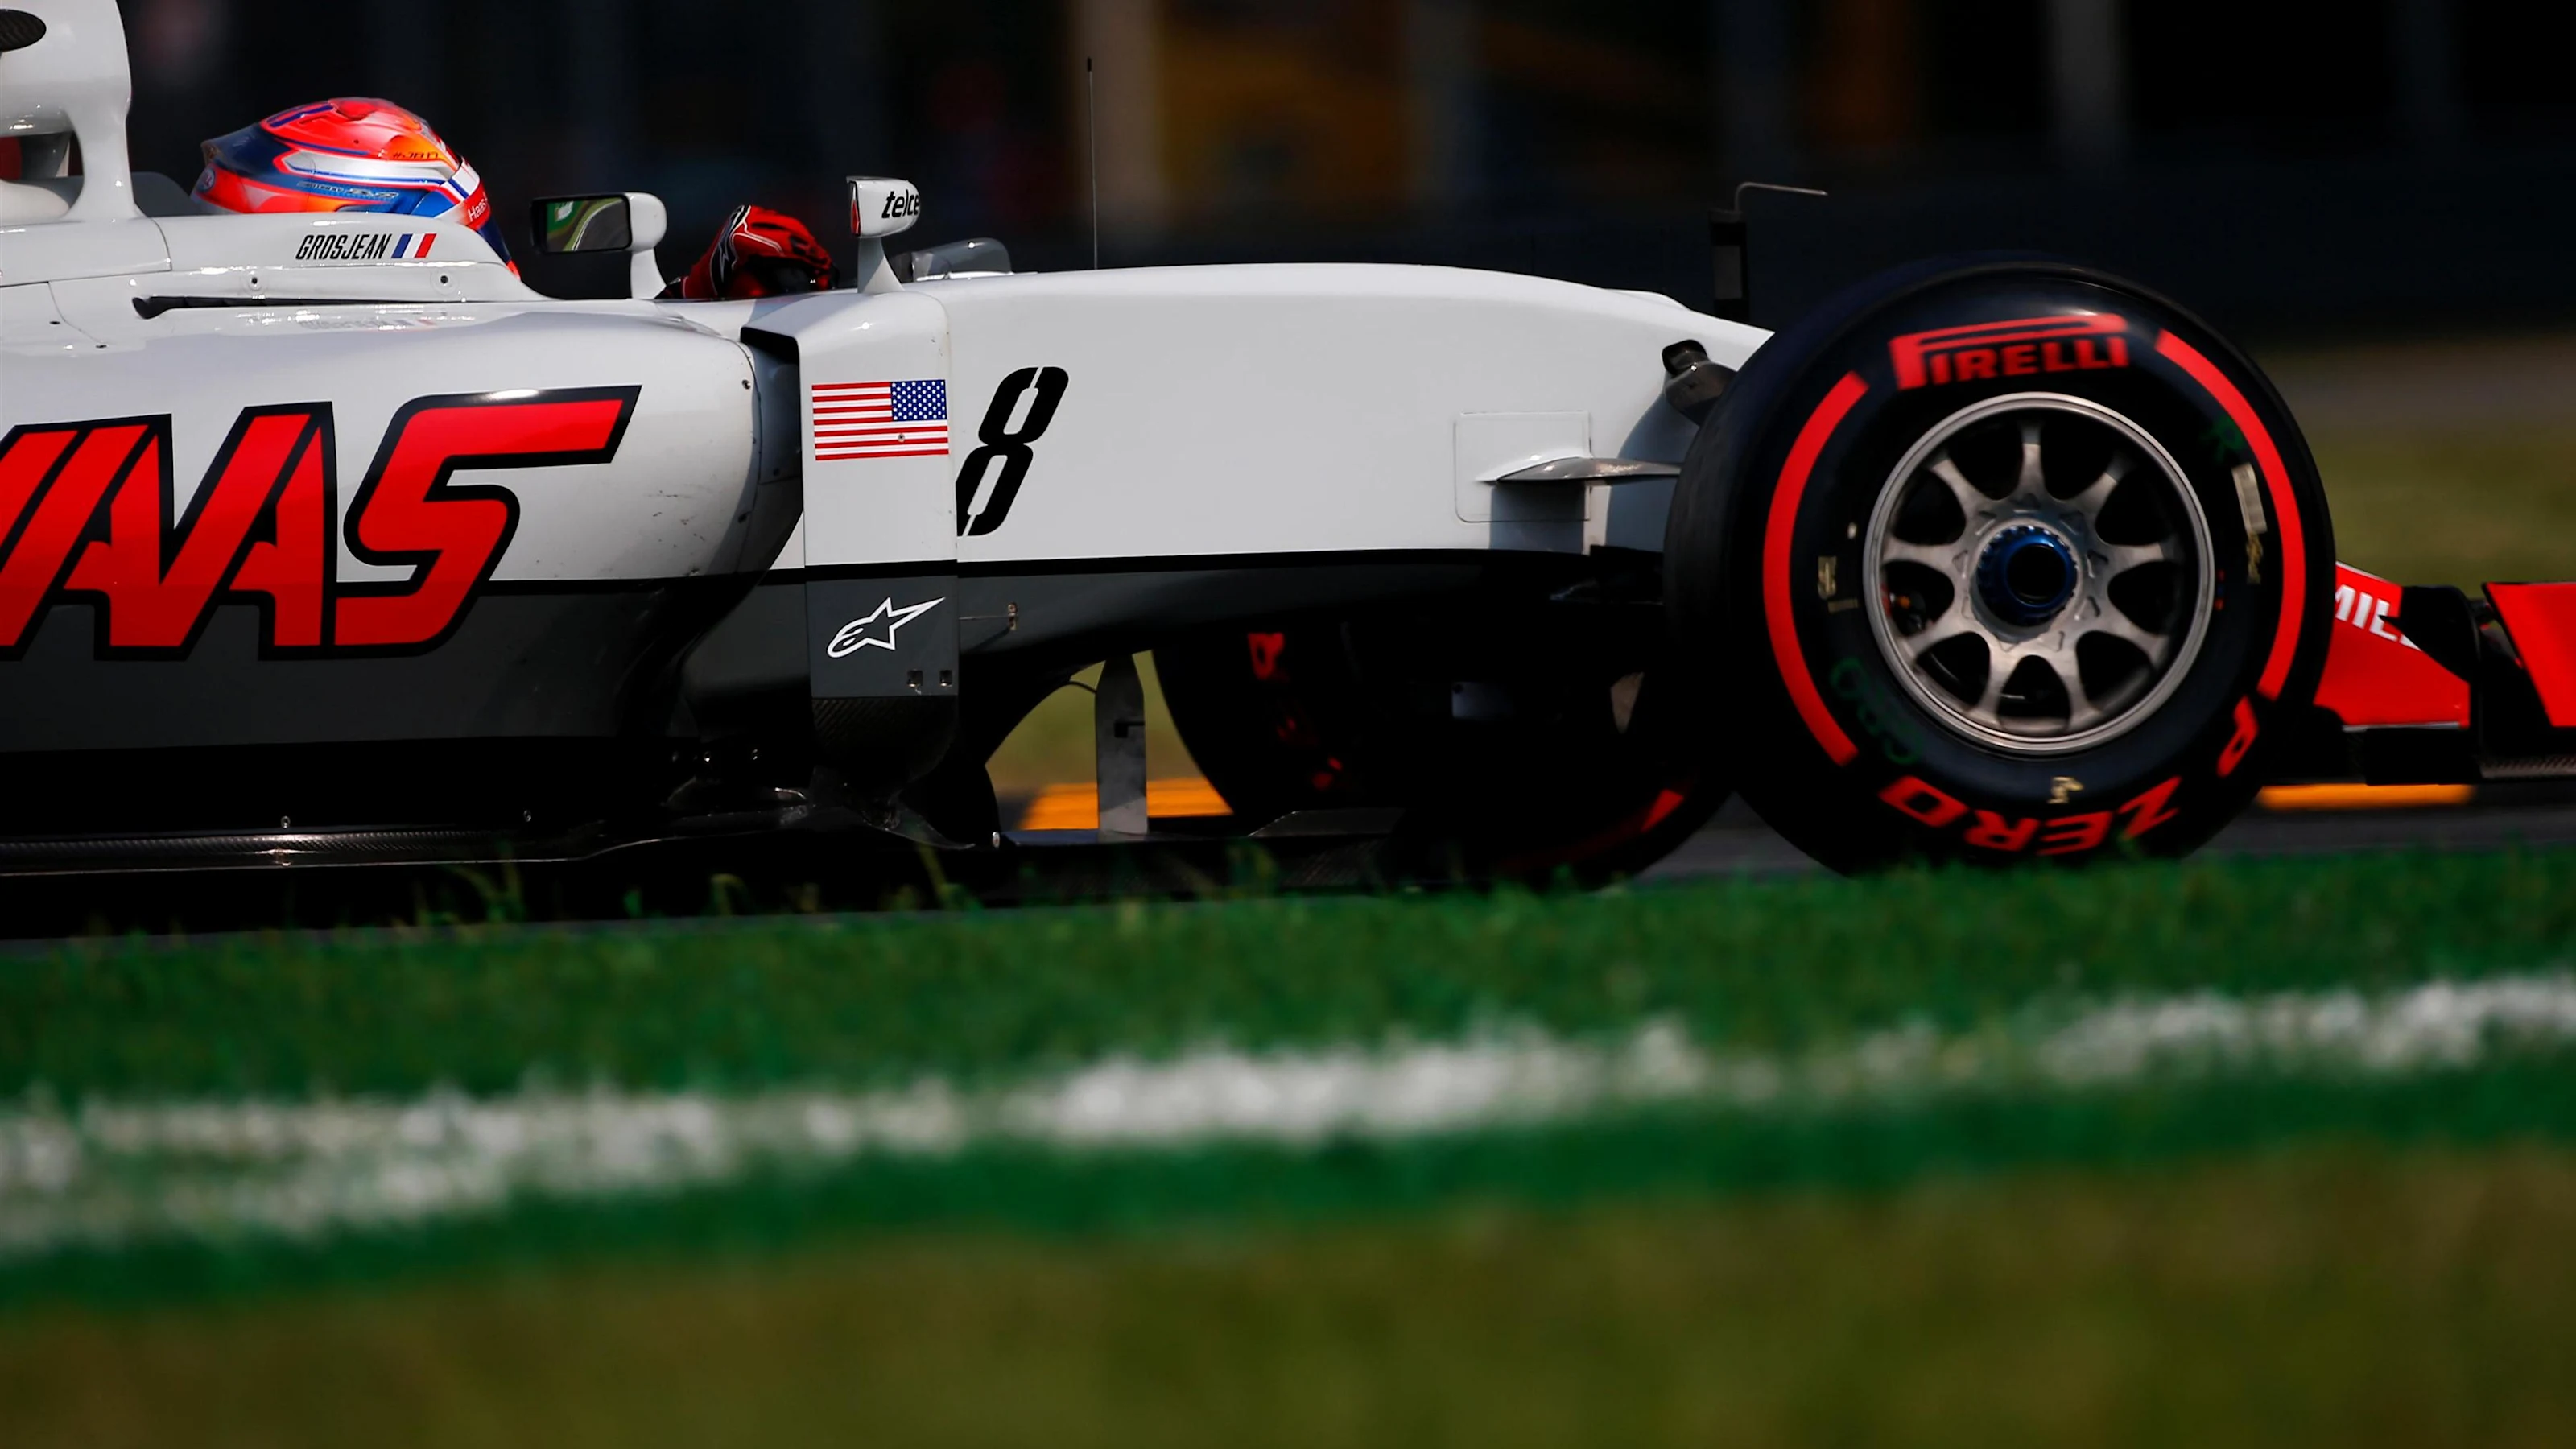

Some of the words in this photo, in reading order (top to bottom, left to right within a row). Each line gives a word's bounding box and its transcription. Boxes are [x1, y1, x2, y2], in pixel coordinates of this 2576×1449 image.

[295, 233, 393, 260] GROSJEAN
[1889, 312, 2129, 390] PIRELLI
[955, 366, 1069, 537] 8
[2216, 694, 2260, 779] P
[1877, 774, 2183, 857] ZERO
